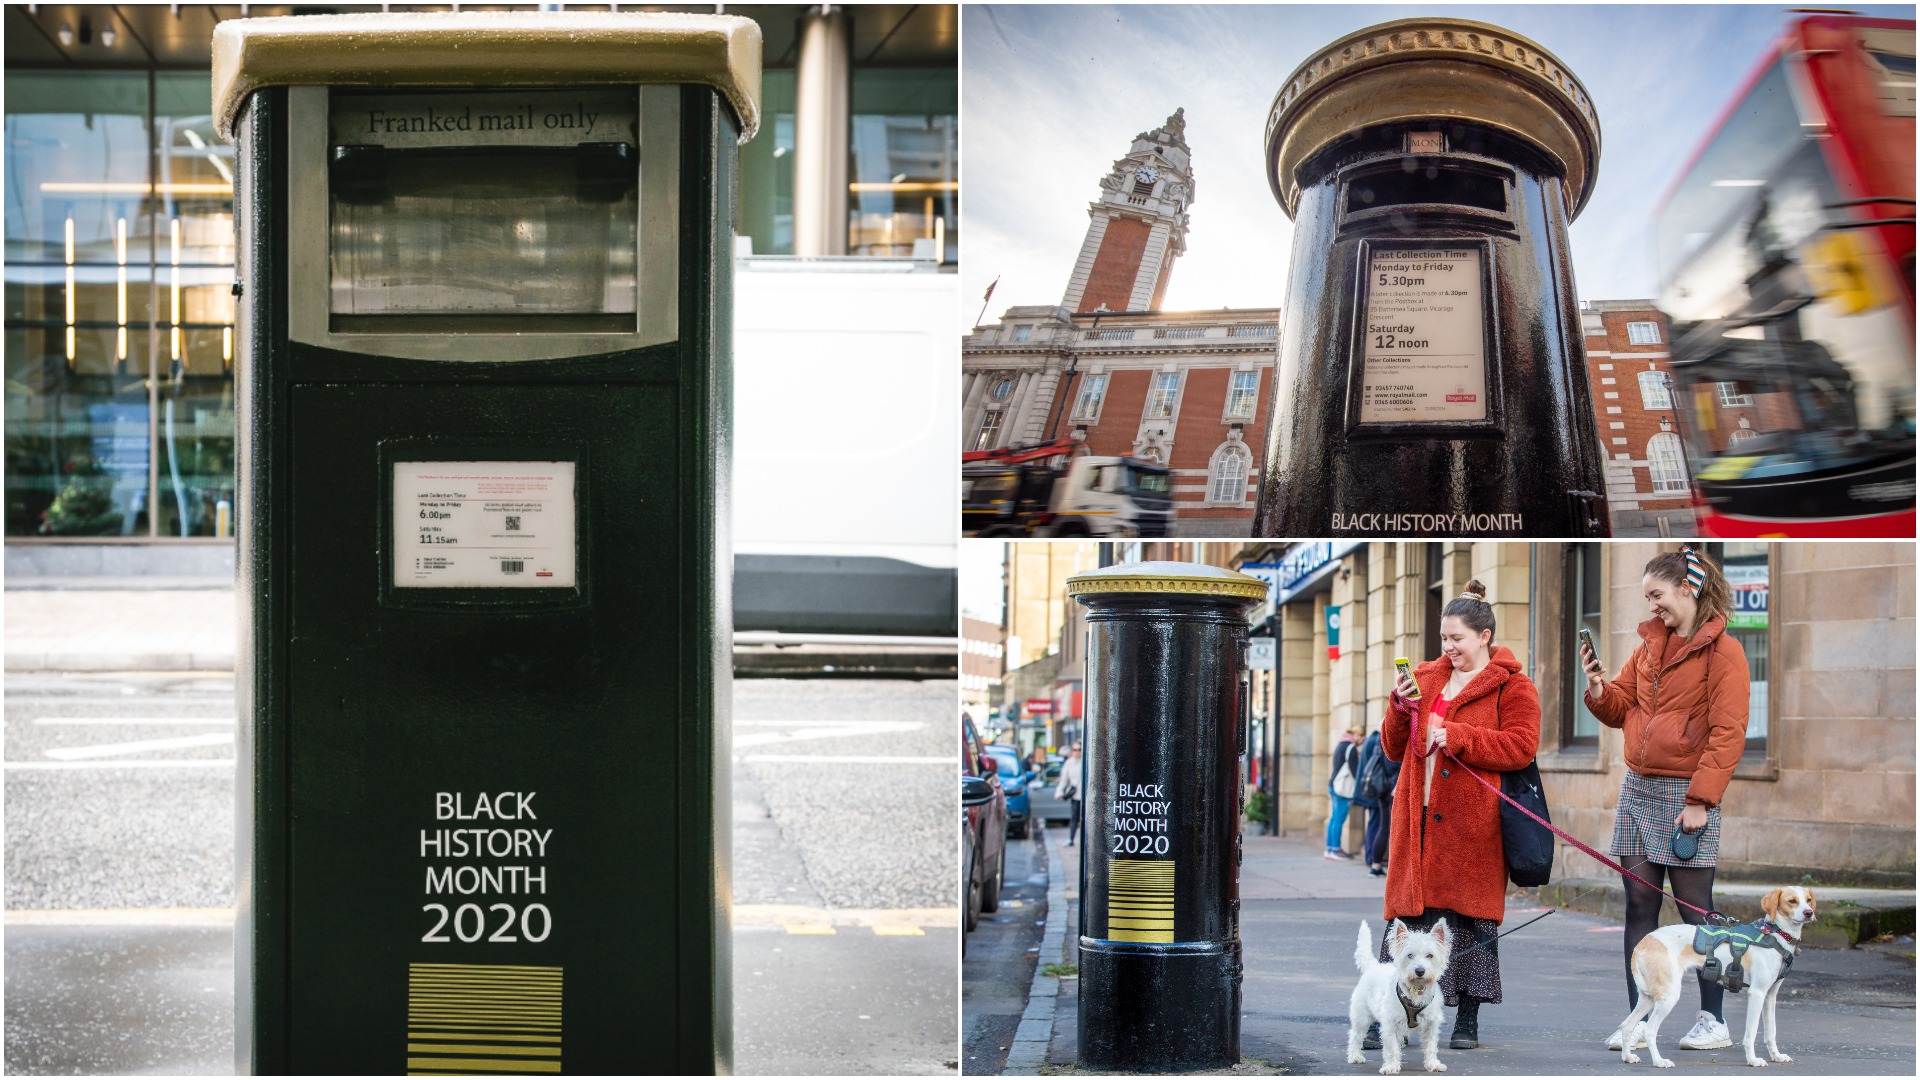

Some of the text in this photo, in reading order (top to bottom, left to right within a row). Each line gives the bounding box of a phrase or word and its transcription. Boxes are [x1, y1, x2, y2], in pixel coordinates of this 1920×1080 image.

[367, 103, 599, 135] Franked mail only
[1396, 251, 1442, 259] Collection
[1444, 250, 1468, 258] Time
[1374, 264, 1410, 272] Monday
[1424, 263, 1454, 272] Friday
[1379, 274, 1424, 287] 5.30pm
[1370, 324, 1414, 334] Saturday
[1375, 335, 1429, 348] 12 noon
[420, 509, 451, 520] 6.00pm
[1332, 513, 1522, 532] BLACK HISTORY MONTH
[420, 534, 458, 544] 11.15am
[1120, 784, 1164, 798] BLACK
[436, 792, 537, 820] BLACK
[1114, 800, 1171, 814] HISTORY
[1114, 818, 1167, 832] MONTH
[420, 829, 553, 857] HISTORY
[1112, 834, 1169, 854] 2020
[426, 866, 546, 894] MONTH
[422, 903, 552, 942] 2020
